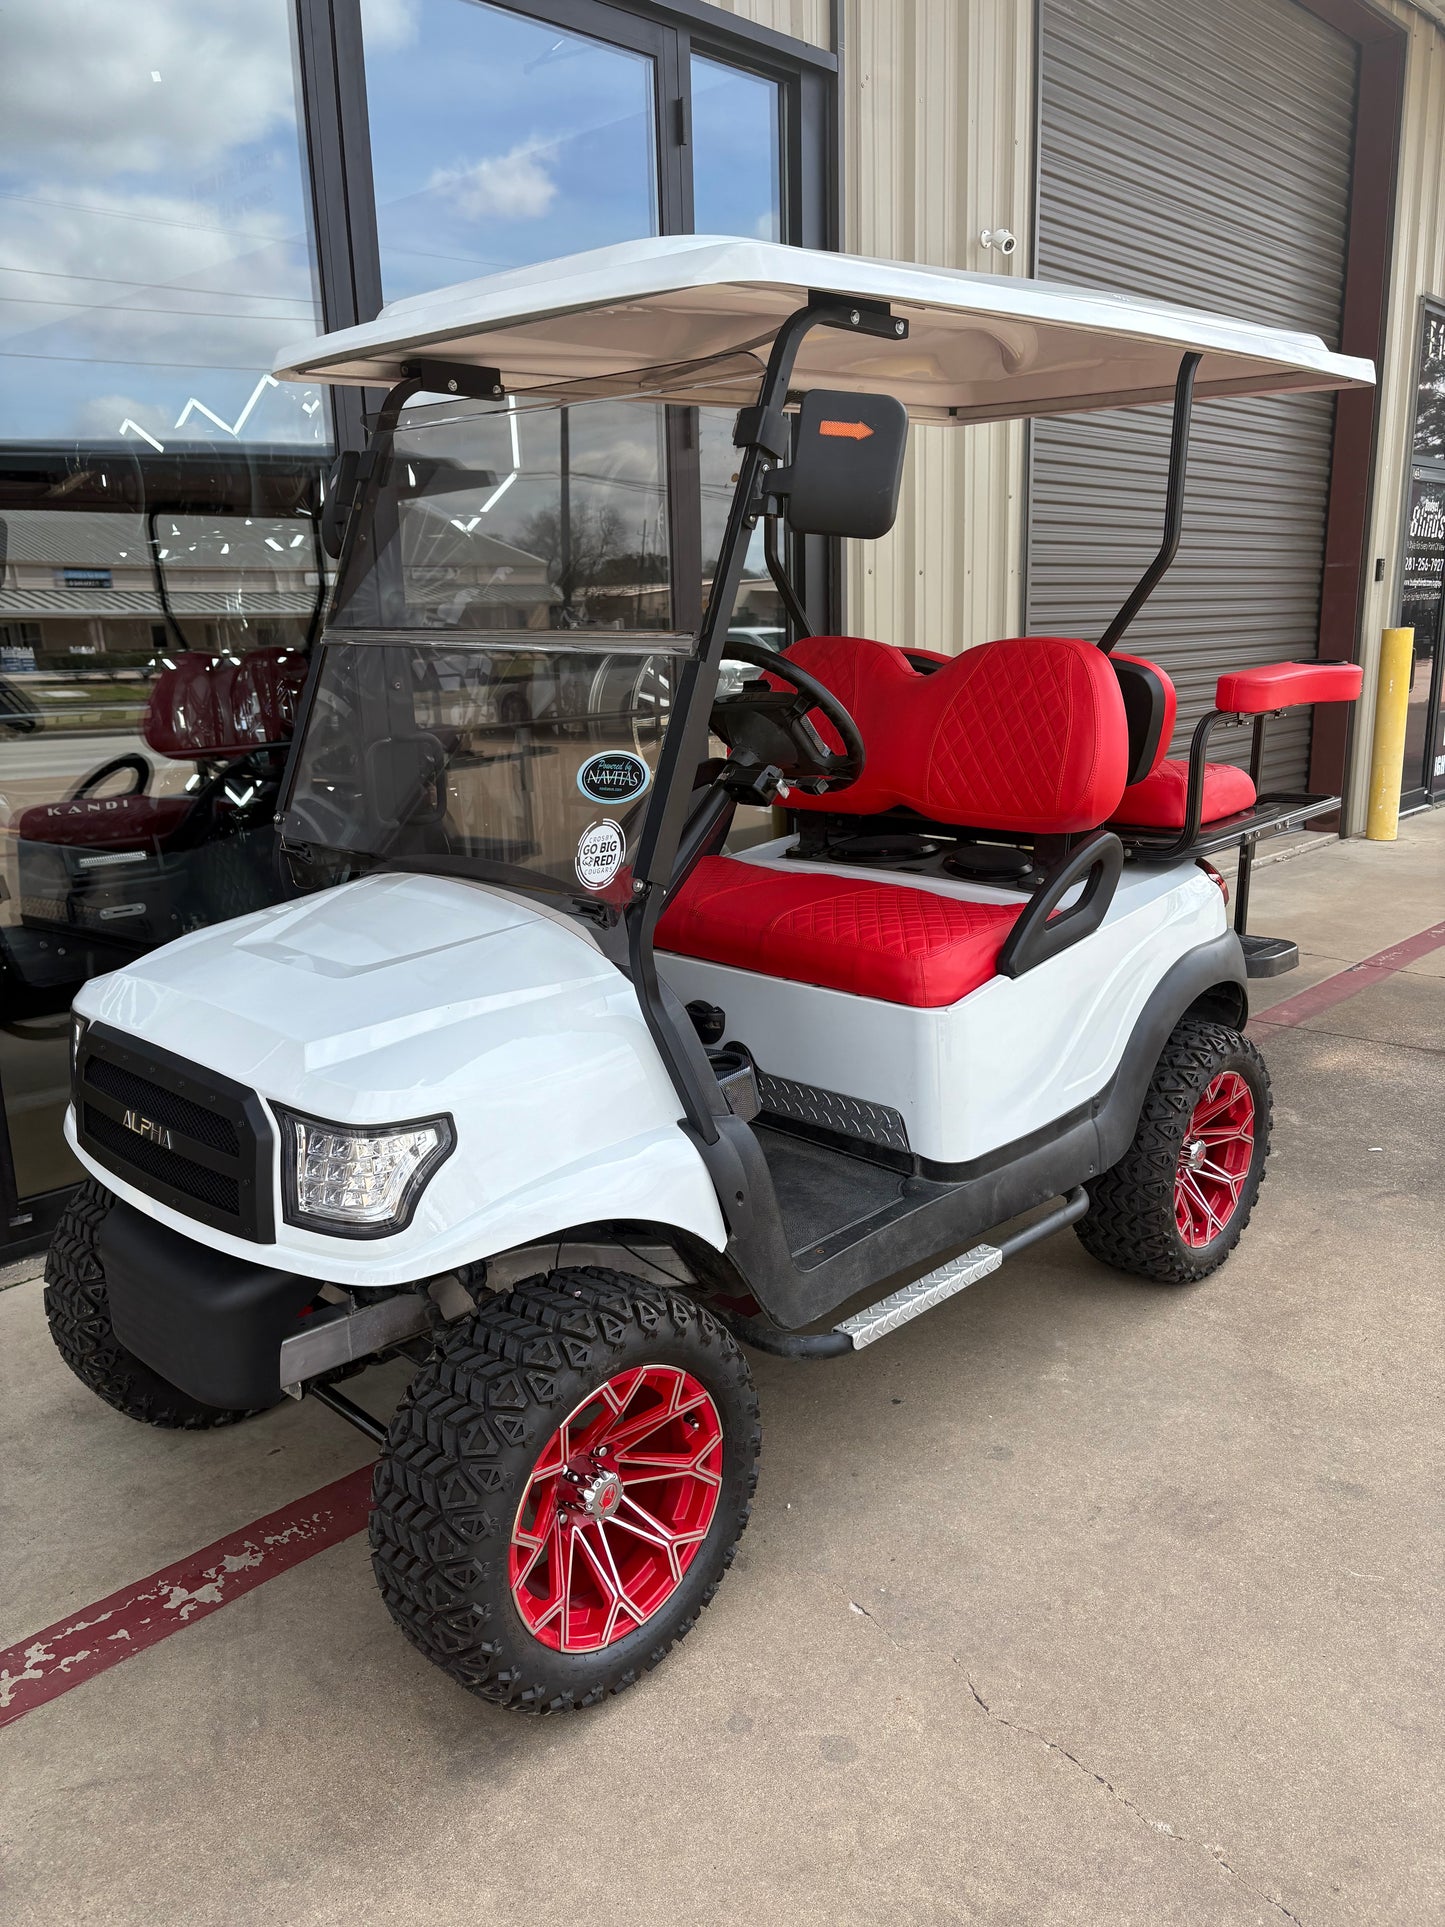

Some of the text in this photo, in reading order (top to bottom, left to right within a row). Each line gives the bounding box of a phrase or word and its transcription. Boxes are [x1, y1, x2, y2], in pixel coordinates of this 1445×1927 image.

[1410, 505, 1445, 539] Blinds
[1405, 557, 1444, 571] 281-256-7927
[598, 760, 633, 771] Powered by
[586, 770, 640, 787] NAVITAS
[47, 800, 129, 816] KANDI
[589, 834, 614, 843] CROSBY
[583, 840, 617, 855] GO BIG
[593, 854, 616, 867] RED!
[584, 866, 613, 875] COUGARS
[122, 1110, 172, 1150] ALPHA
